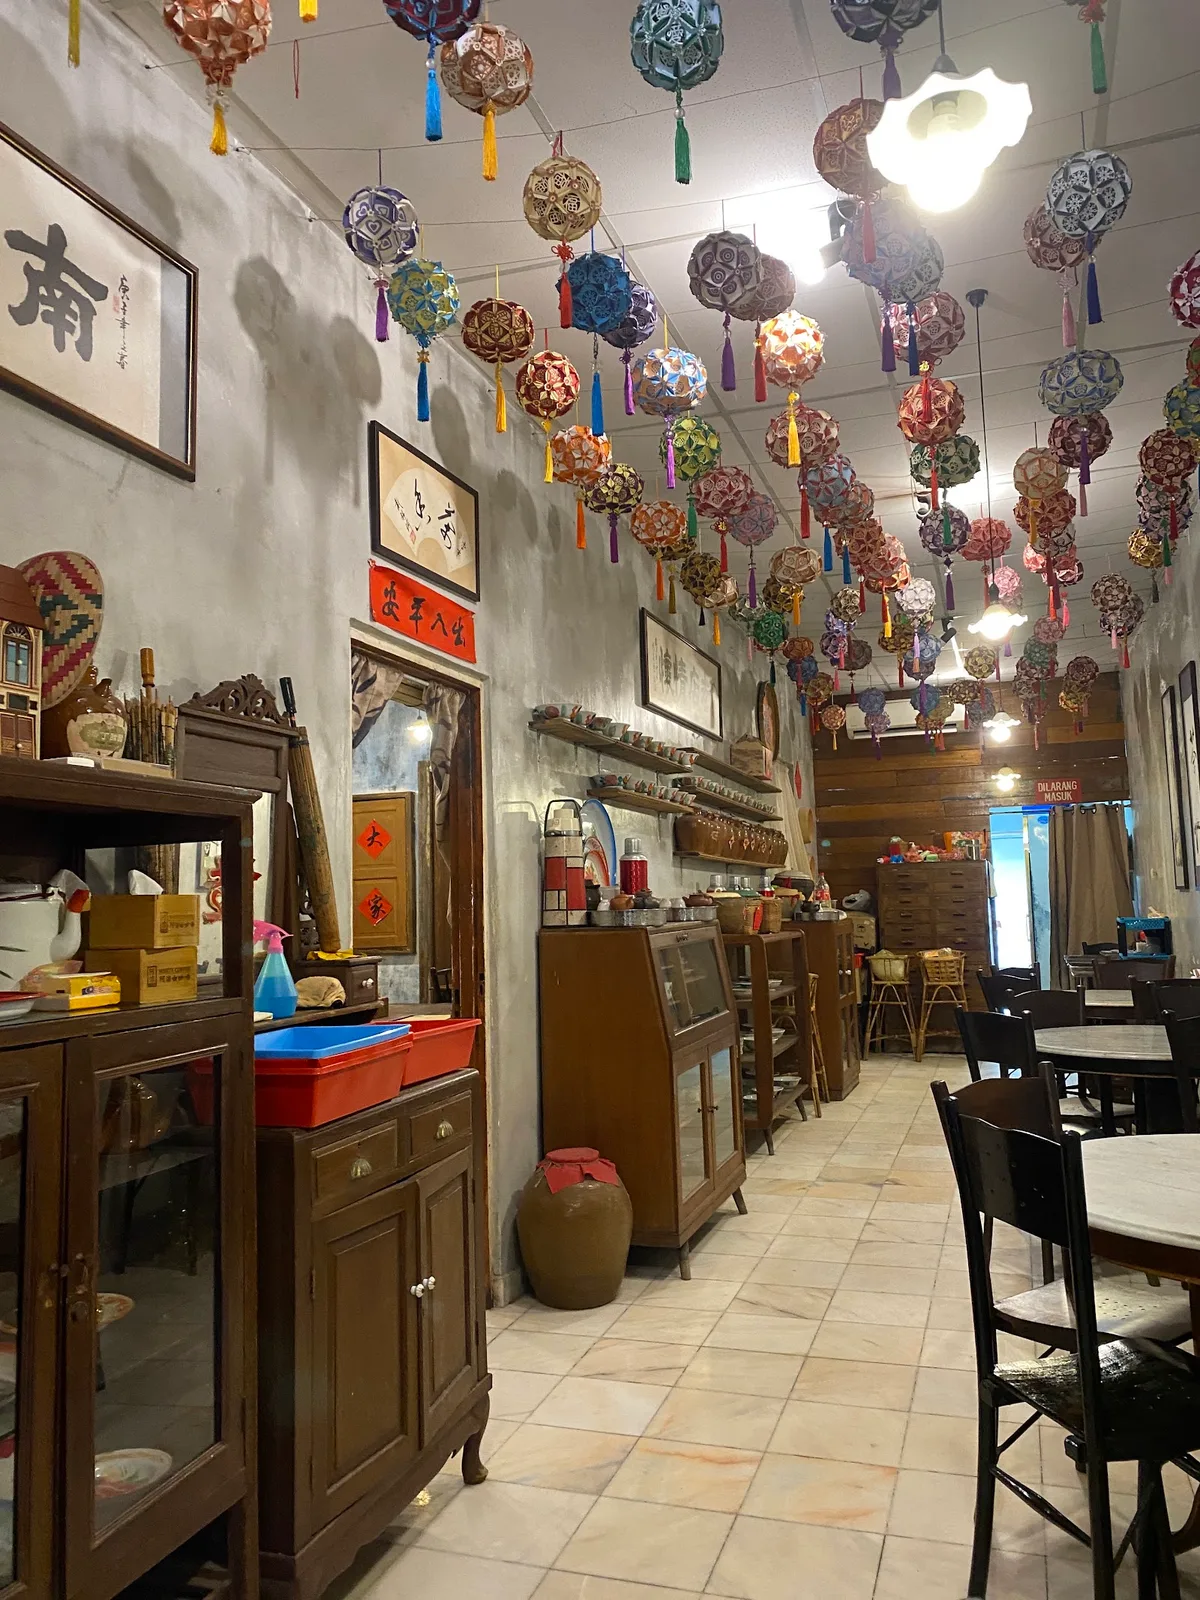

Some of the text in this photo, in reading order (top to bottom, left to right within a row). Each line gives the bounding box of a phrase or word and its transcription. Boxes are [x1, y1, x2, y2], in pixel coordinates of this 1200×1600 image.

[4, 223, 109, 362] 南
[1037, 781, 1077, 792] DILARANG
[1044, 791, 1072, 802] MASUK
[366, 826, 383, 847] 大
[367, 894, 386, 919] 家
